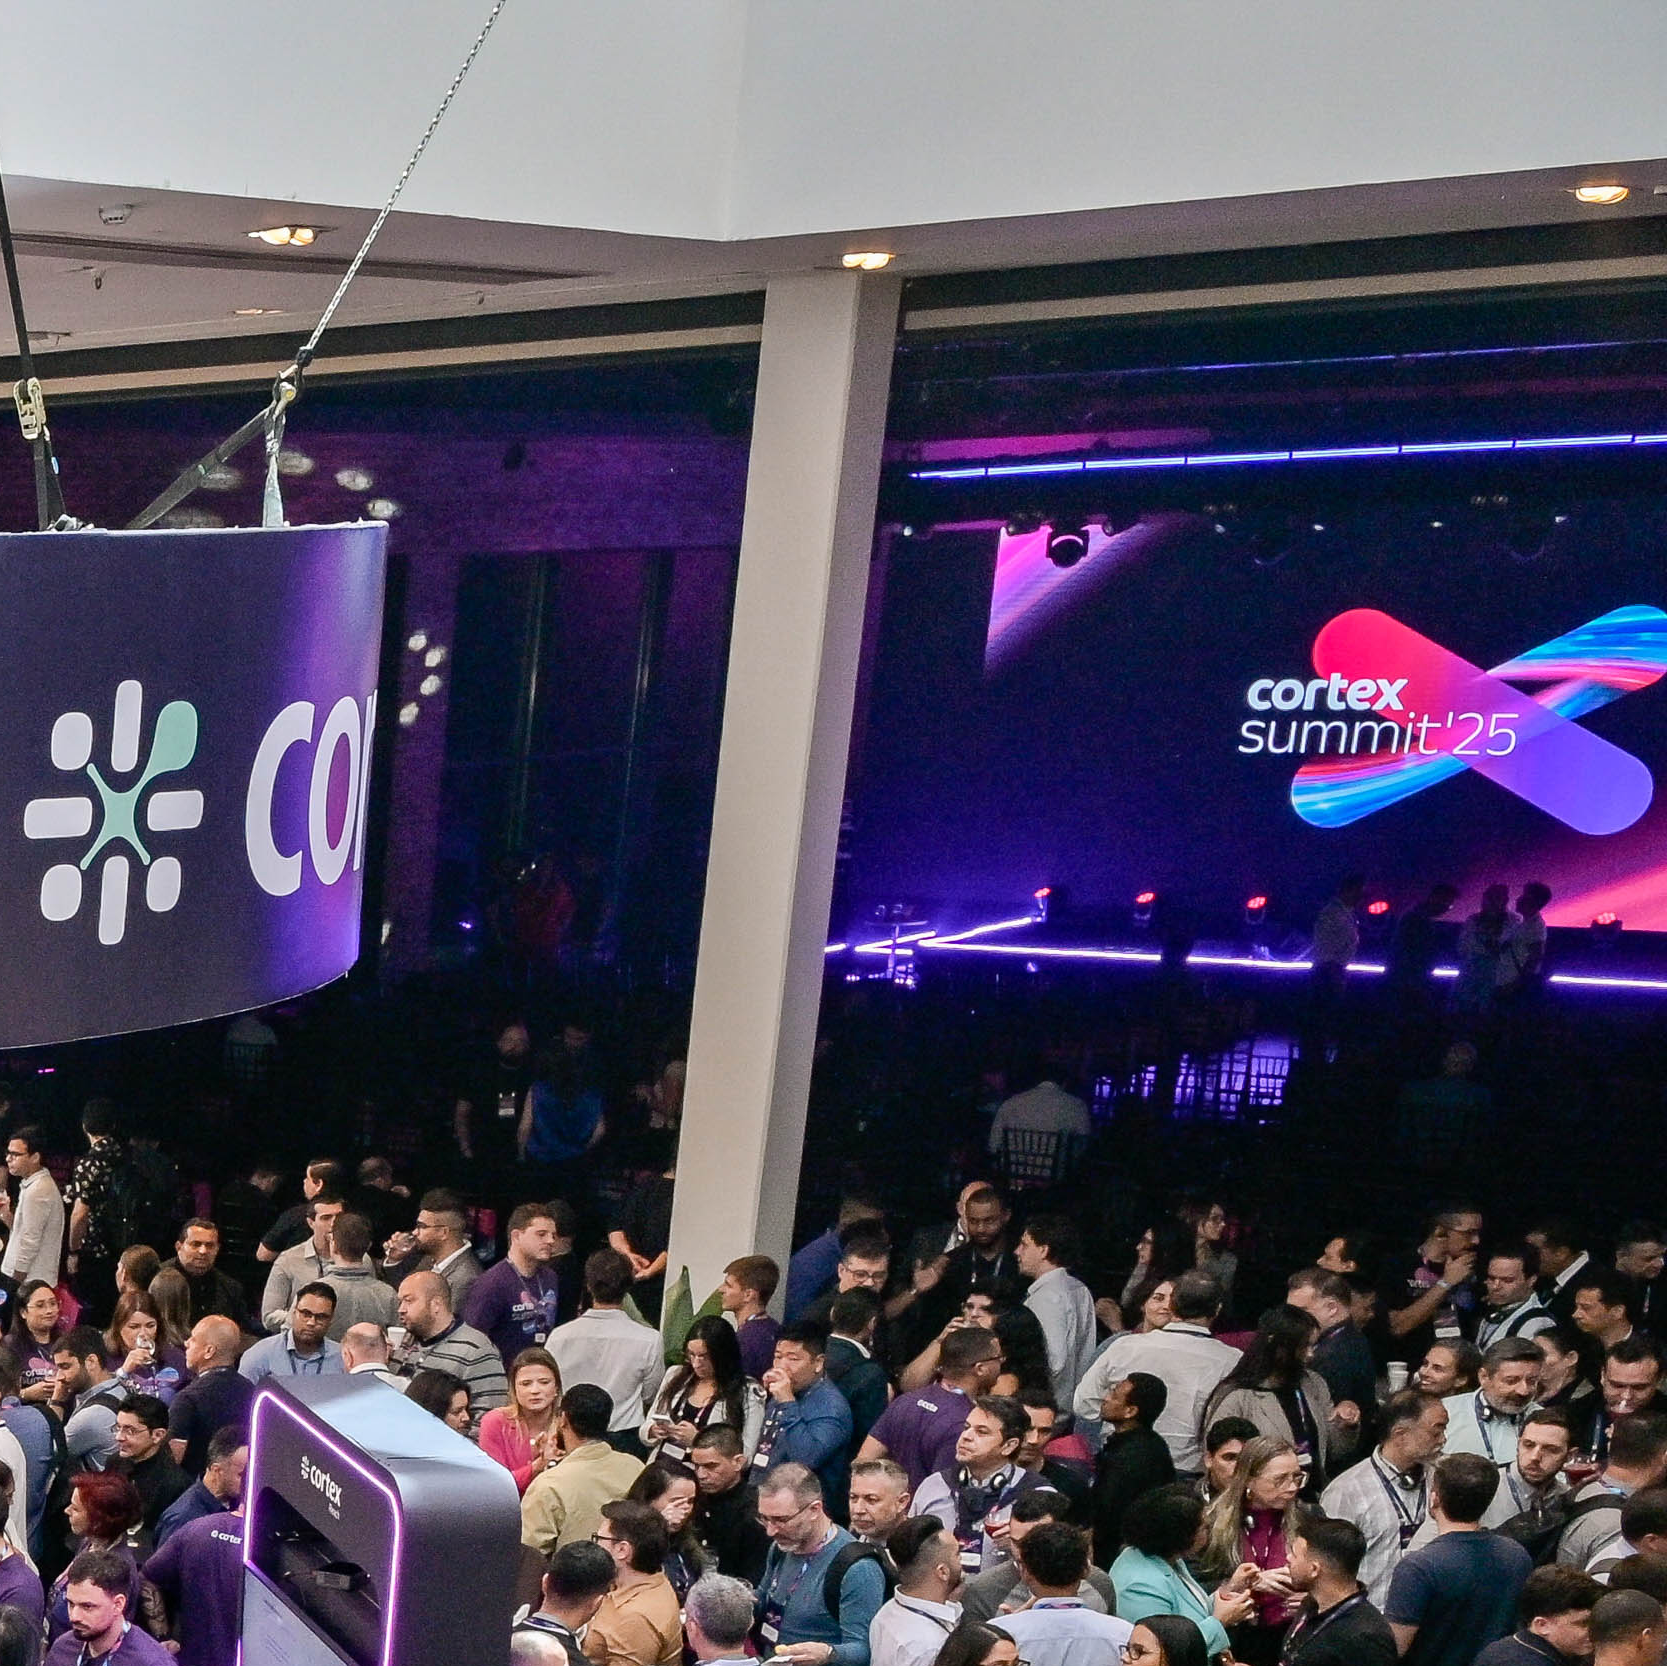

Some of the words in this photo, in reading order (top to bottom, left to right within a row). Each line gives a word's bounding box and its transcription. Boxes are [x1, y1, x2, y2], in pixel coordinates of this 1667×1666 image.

[1247, 672, 1408, 711] cortex
[1238, 711, 1519, 756] summit'25
[245, 688, 378, 897] cor
[310, 1463, 342, 1507] cortex
